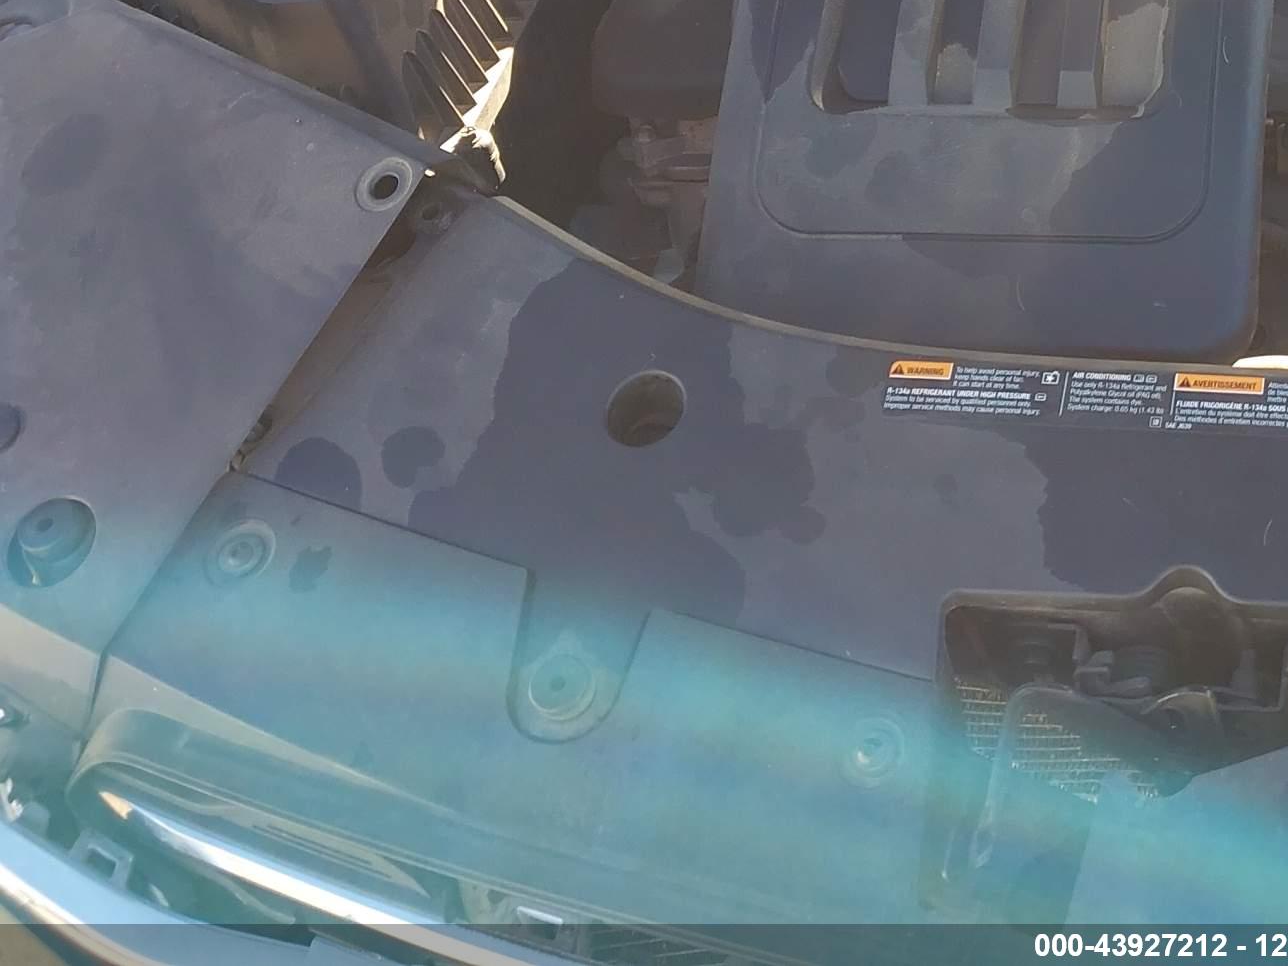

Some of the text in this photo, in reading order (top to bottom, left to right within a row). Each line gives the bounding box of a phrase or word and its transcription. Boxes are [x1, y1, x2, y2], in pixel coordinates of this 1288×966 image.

[906, 366, 944, 375] WARNING
[964, 367, 978, 376] help
[995, 369, 1022, 378] personal
[1085, 372, 1131, 381] CONDITIONING
[1084, 381, 1096, 389] only
[1193, 380, 1257, 390] AVERTISSEMENT
[912, 388, 956, 396] REFRIGERANT
[997, 392, 1031, 400] PRESSURE
[960, 398, 986, 406] qualified
[1177, 400, 1198, 408] FLUIDE
[1244, 403, 1267, 411] R-134a
[1268, 404, 1286, 412] SOUS
[884, 402, 911, 410] Improper
[995, 407, 1021, 415] personal
[1068, 404, 1090, 412] System
[1252, 419, 1285, 427] incorrectes
